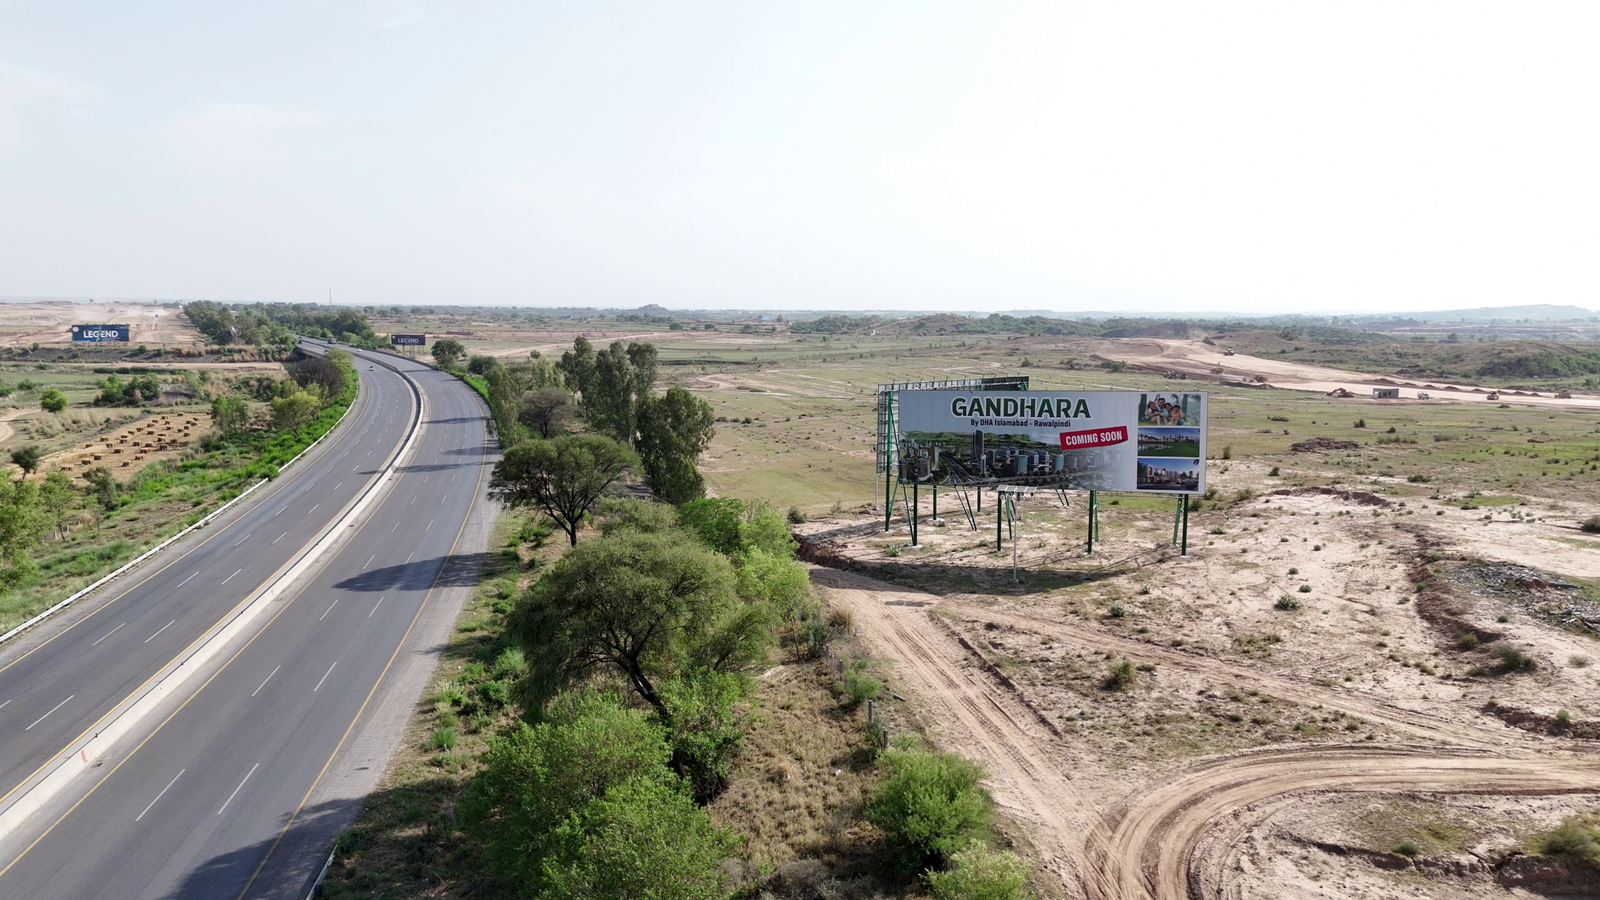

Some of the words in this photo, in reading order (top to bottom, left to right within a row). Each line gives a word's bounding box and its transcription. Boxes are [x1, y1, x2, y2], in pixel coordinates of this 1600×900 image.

[83, 330, 119, 338] LEGEND
[952, 397, 1091, 418] GANDHARA
[970, 419, 978, 427] By
[995, 419, 1028, 427] Islamabad
[1034, 420, 1071, 428] Rawalpindi
[1065, 433, 1098, 446] COMING
[1100, 430, 1122, 442] SOON
